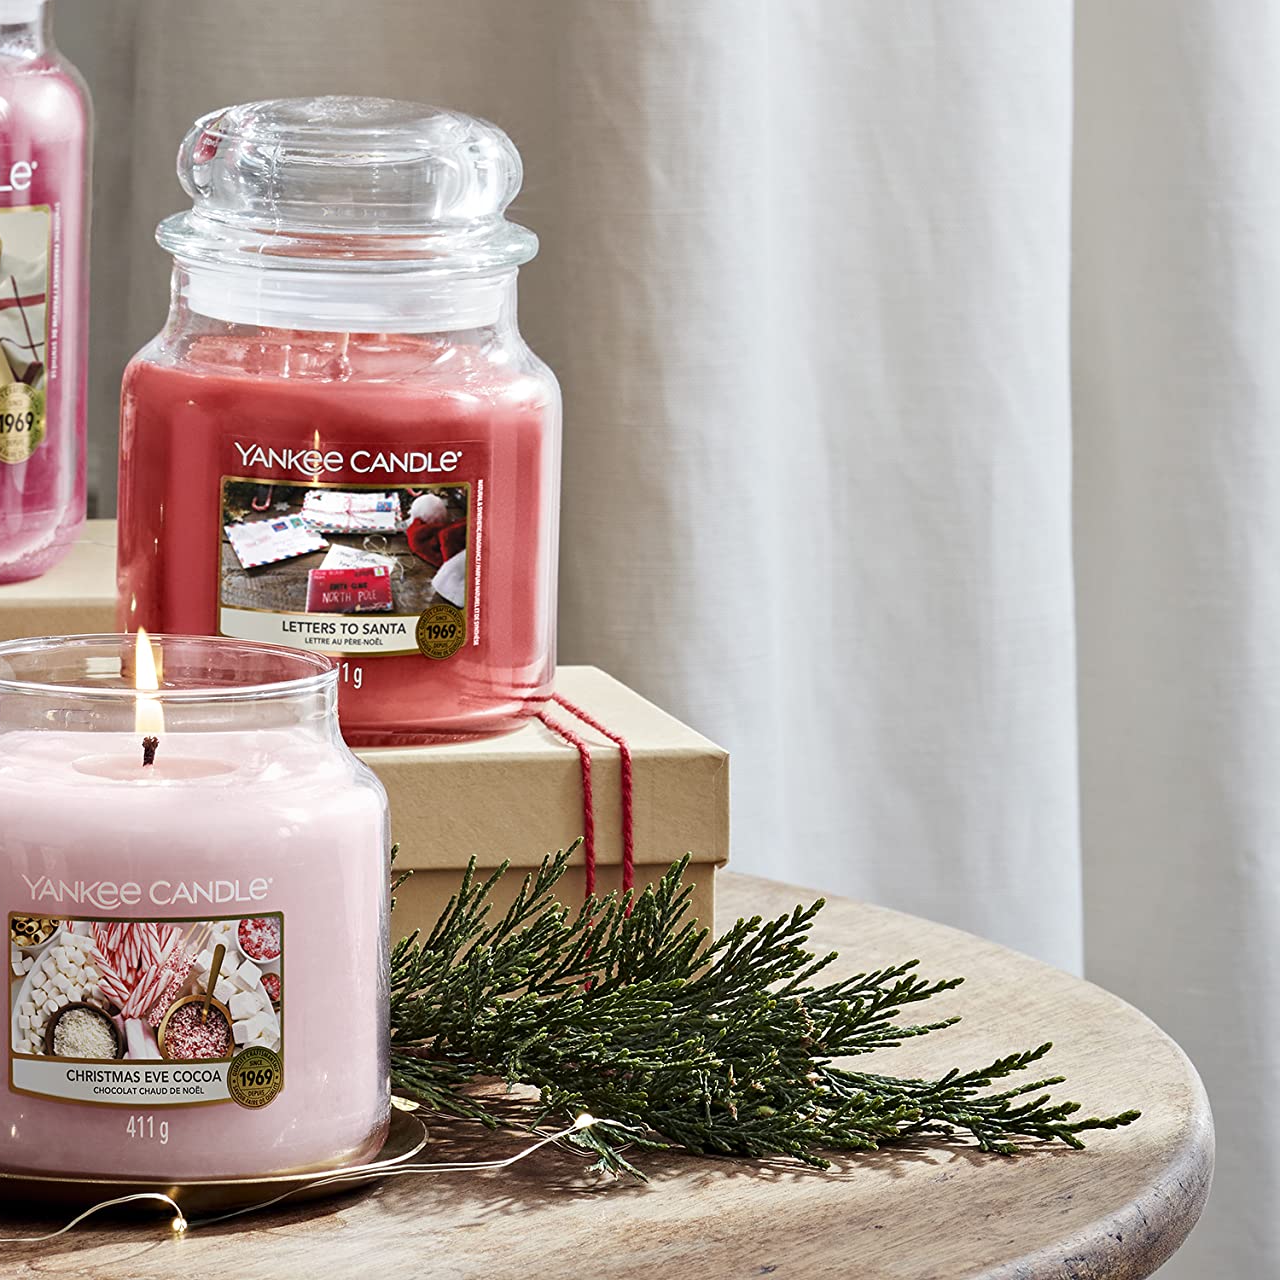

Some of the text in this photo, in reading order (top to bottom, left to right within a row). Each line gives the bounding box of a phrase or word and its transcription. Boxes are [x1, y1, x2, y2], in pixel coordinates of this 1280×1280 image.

[322, 589, 377, 604] NORTH POLE
[282, 620, 406, 635] LETTERS TO SANTA
[426, 624, 456, 639] 1969
[305, 637, 331, 645] LETTRE
[344, 635, 383, 646] PÈRE-NOËL
[353, 667, 362, 689] g
[66, 1070, 222, 1083] CHRISTMAS EVE COCOA
[240, 1069, 273, 1087] 1969
[93, 1085, 204, 1095] CHOCOLAT CHAUD DE NOËL
[126, 1116, 169, 1144] 411 g
